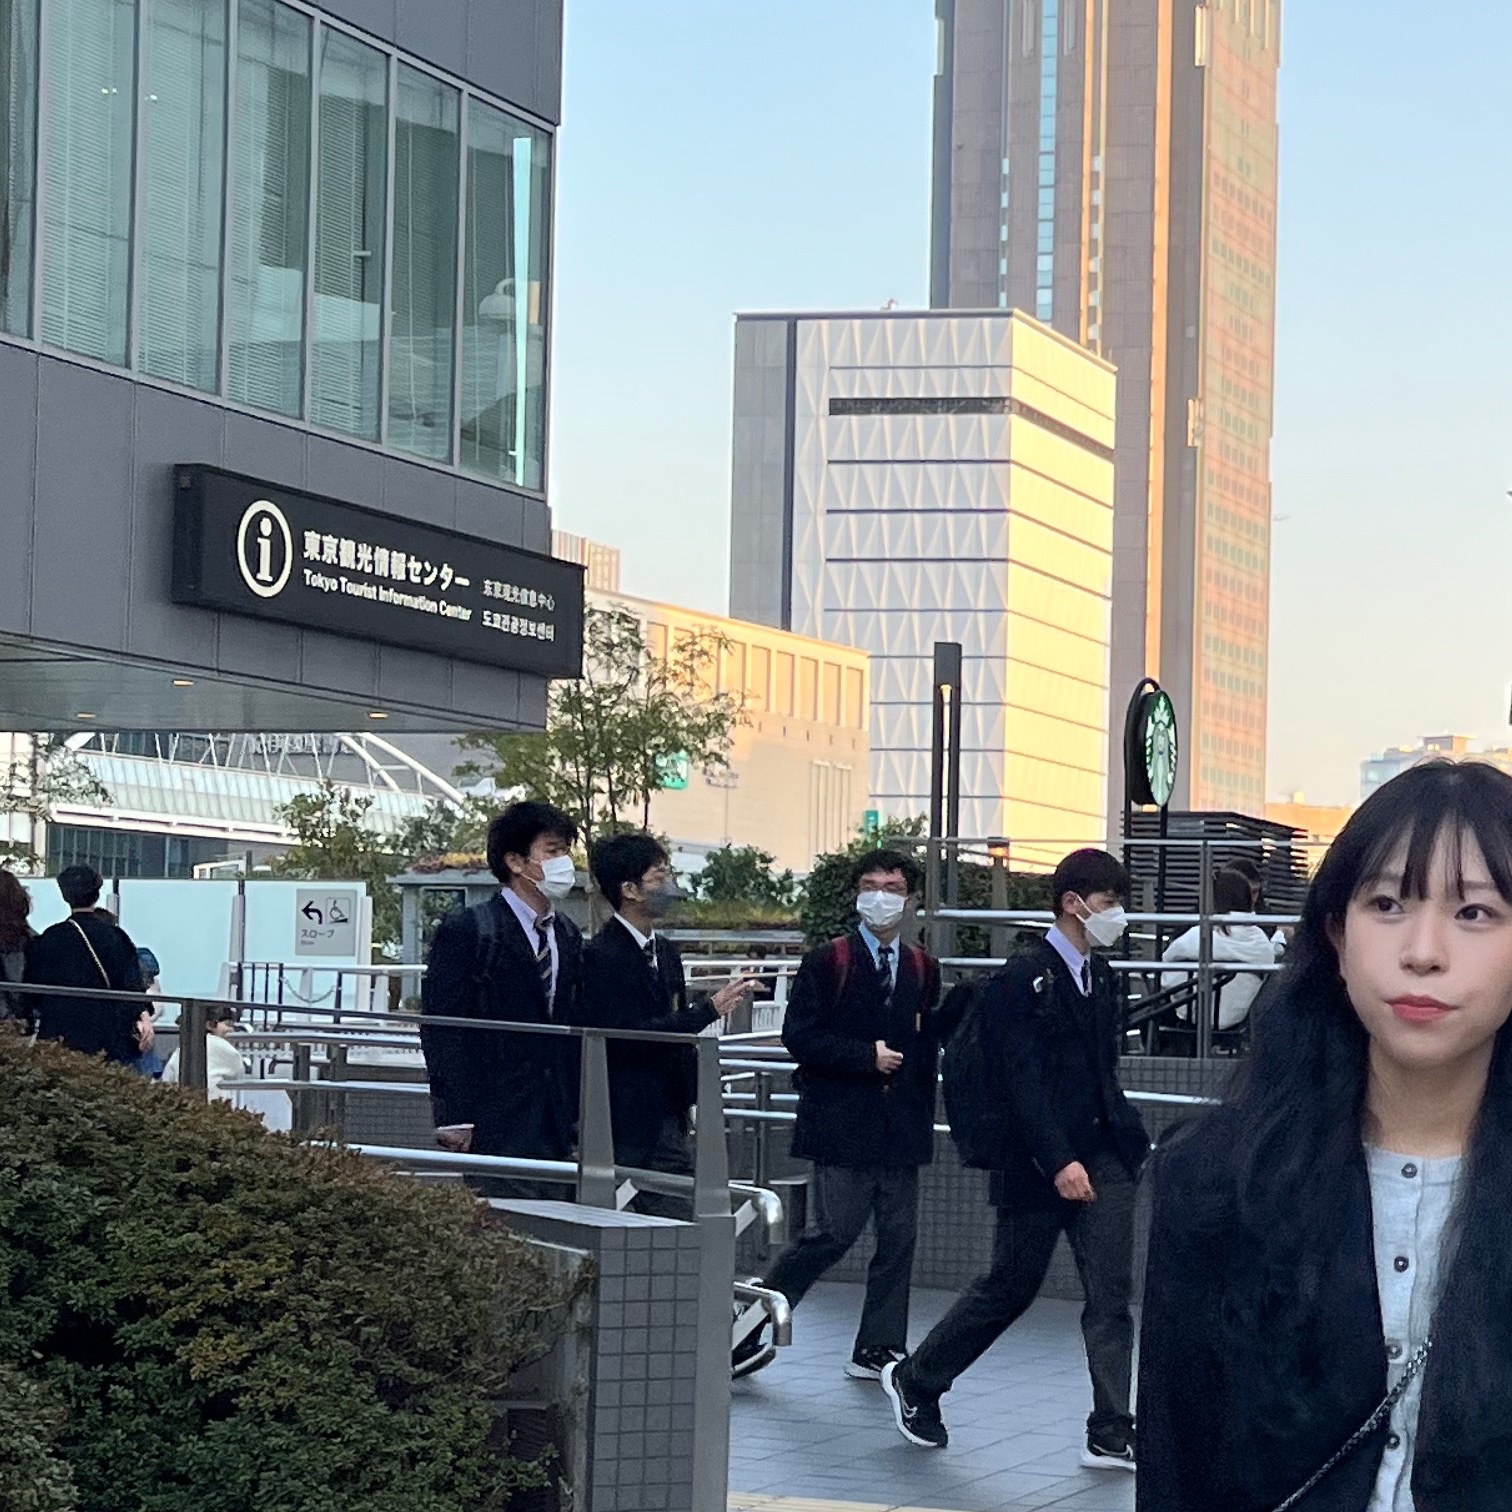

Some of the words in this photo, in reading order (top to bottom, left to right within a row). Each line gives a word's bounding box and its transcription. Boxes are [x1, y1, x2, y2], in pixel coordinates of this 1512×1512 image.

[303, 530, 471, 592] 東京観光情報センター
[303, 568, 338, 593] Tokyo
[339, 576, 377, 600] Tourist
[379, 585, 438, 614] Information
[439, 600, 472, 621] Center
